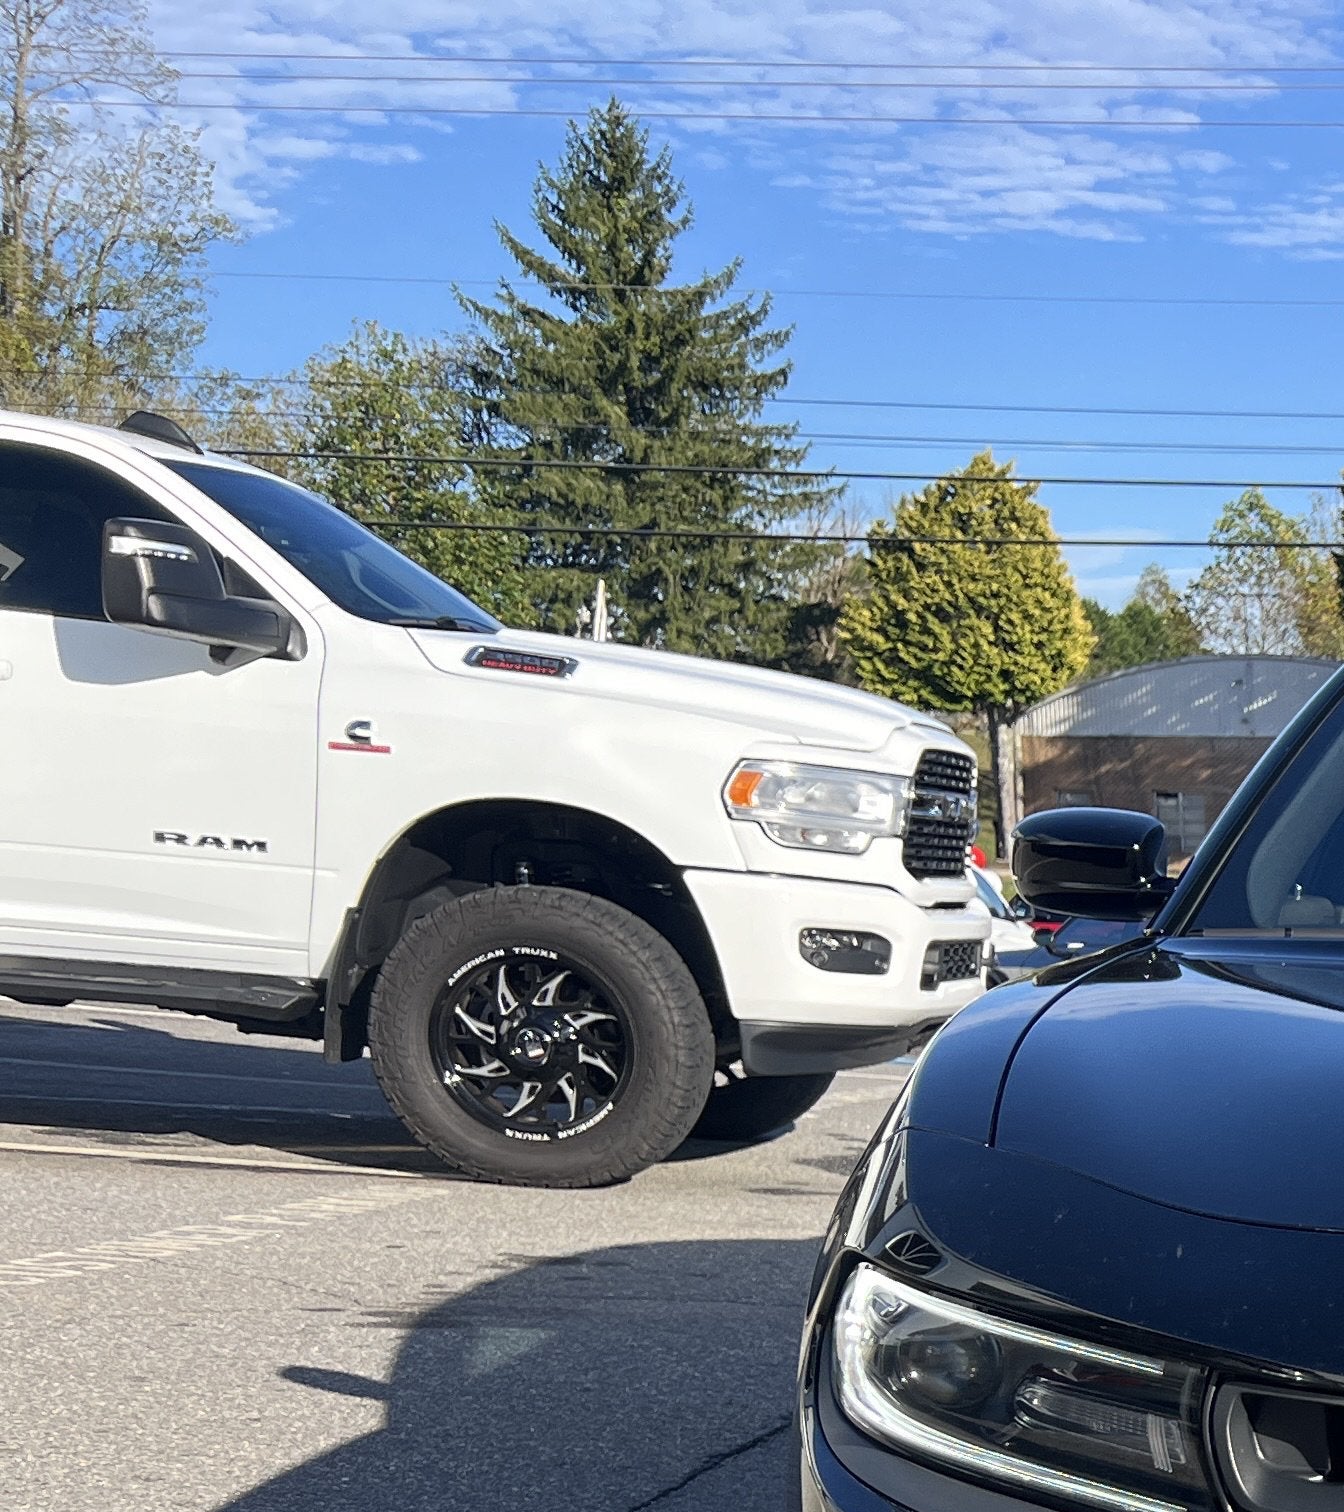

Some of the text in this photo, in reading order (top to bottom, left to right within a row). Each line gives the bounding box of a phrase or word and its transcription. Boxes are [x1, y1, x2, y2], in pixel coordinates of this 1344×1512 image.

[153, 830, 268, 853] RAM
[448, 946, 558, 986] AMERICAN TRUXX
